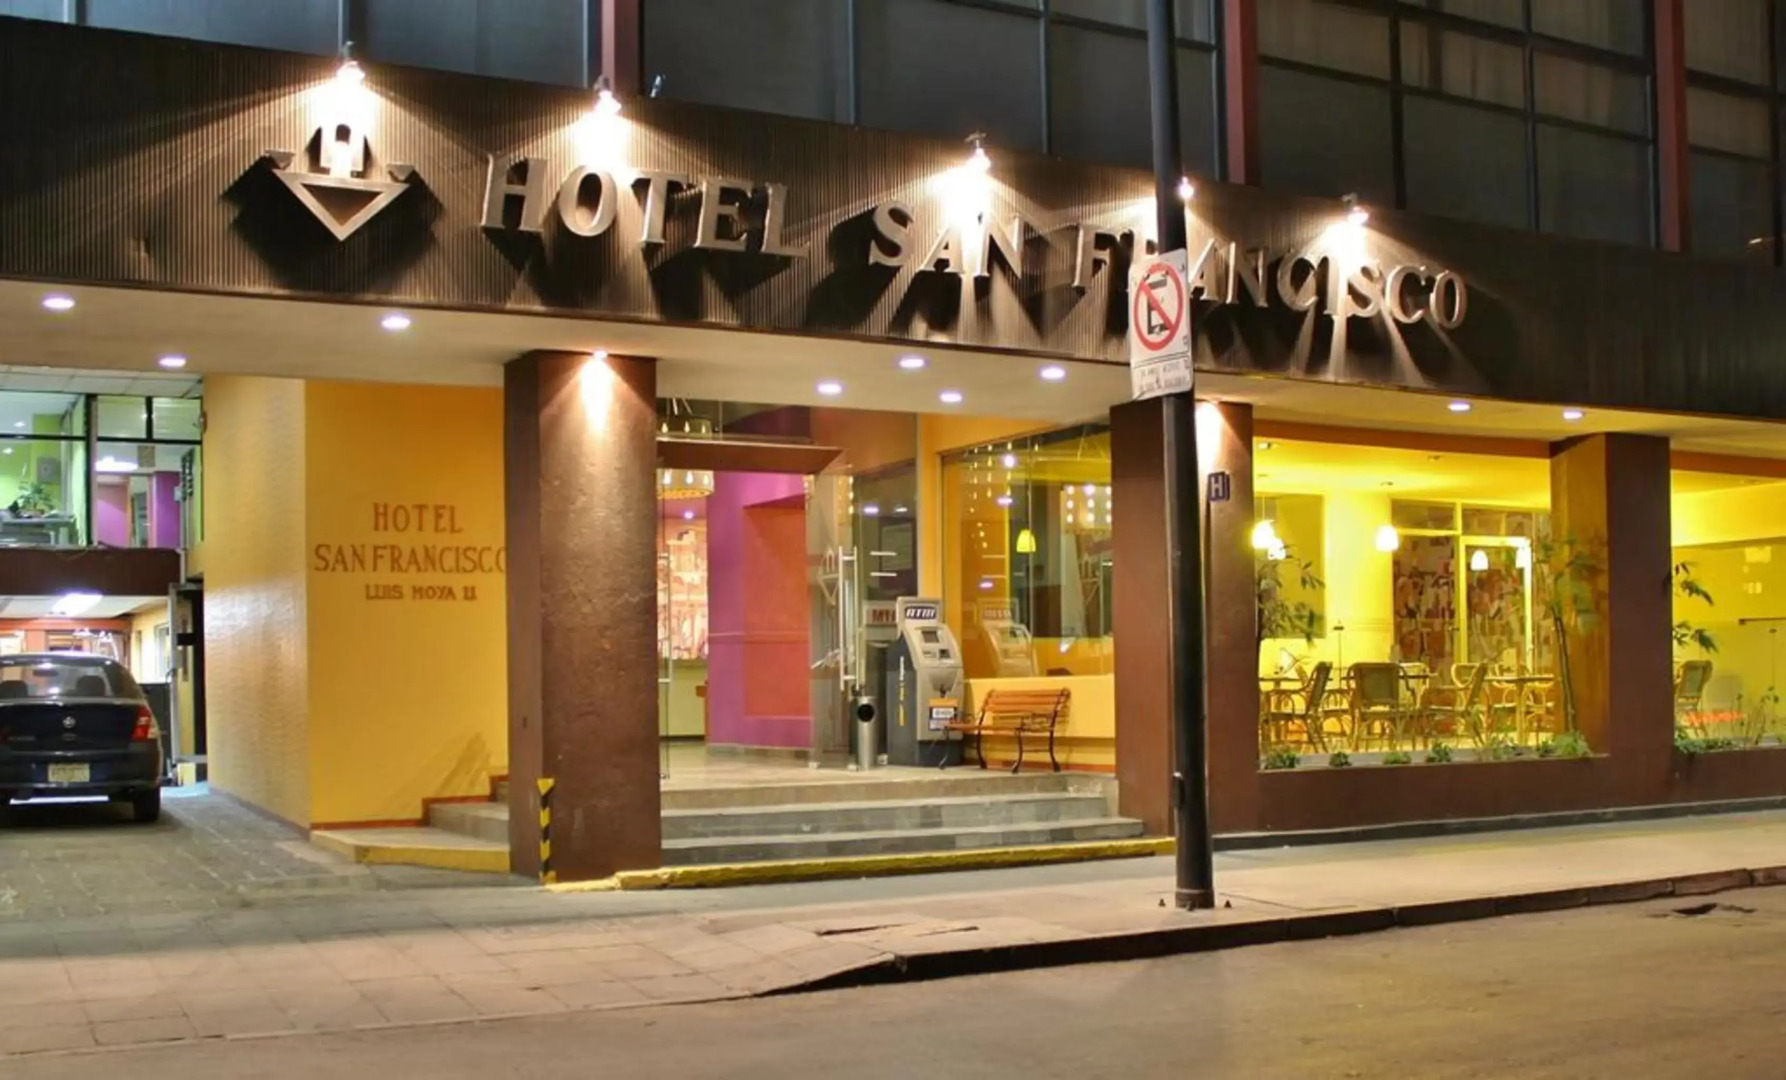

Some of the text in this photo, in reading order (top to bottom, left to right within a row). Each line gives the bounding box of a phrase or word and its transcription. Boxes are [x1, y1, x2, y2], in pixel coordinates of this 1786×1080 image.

[480, 154, 810, 257] HOTEL
[868, 201, 1024, 278] SAN
[373, 502, 464, 533] HOTEL
[365, 583, 404, 601] LUIS
[411, 585, 456, 601] MOYA
